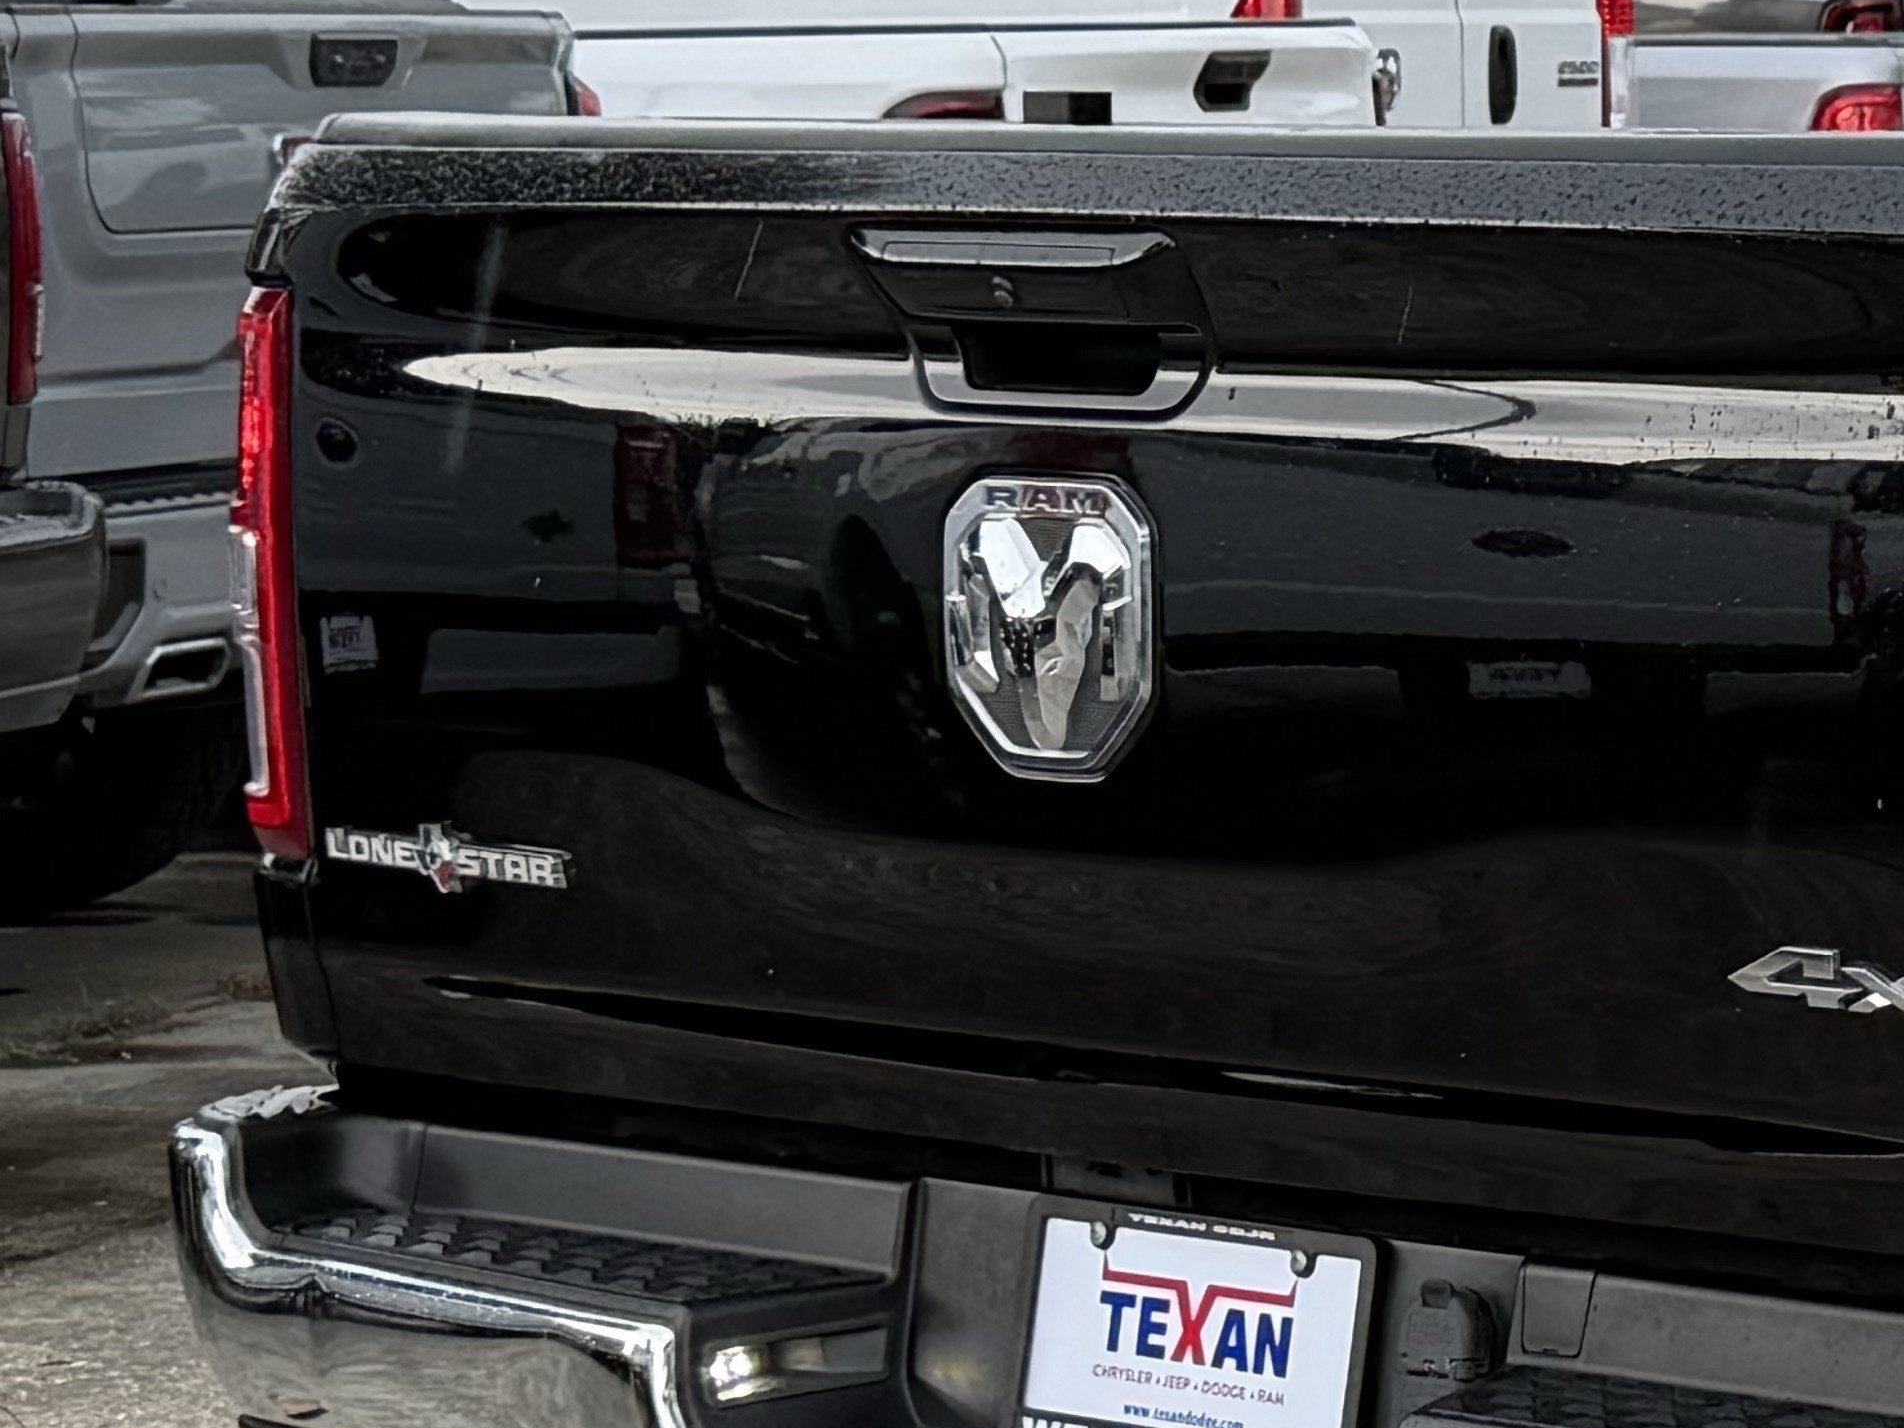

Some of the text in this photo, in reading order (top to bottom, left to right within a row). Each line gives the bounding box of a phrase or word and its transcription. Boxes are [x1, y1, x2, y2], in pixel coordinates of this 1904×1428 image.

[985, 484, 1106, 515] RAM
[326, 828, 562, 888] LONE STAR
[1100, 1253, 1298, 1378] TEXAN
[1093, 1363, 1285, 1406] CHRYSLER JEEP DODGE RAM
